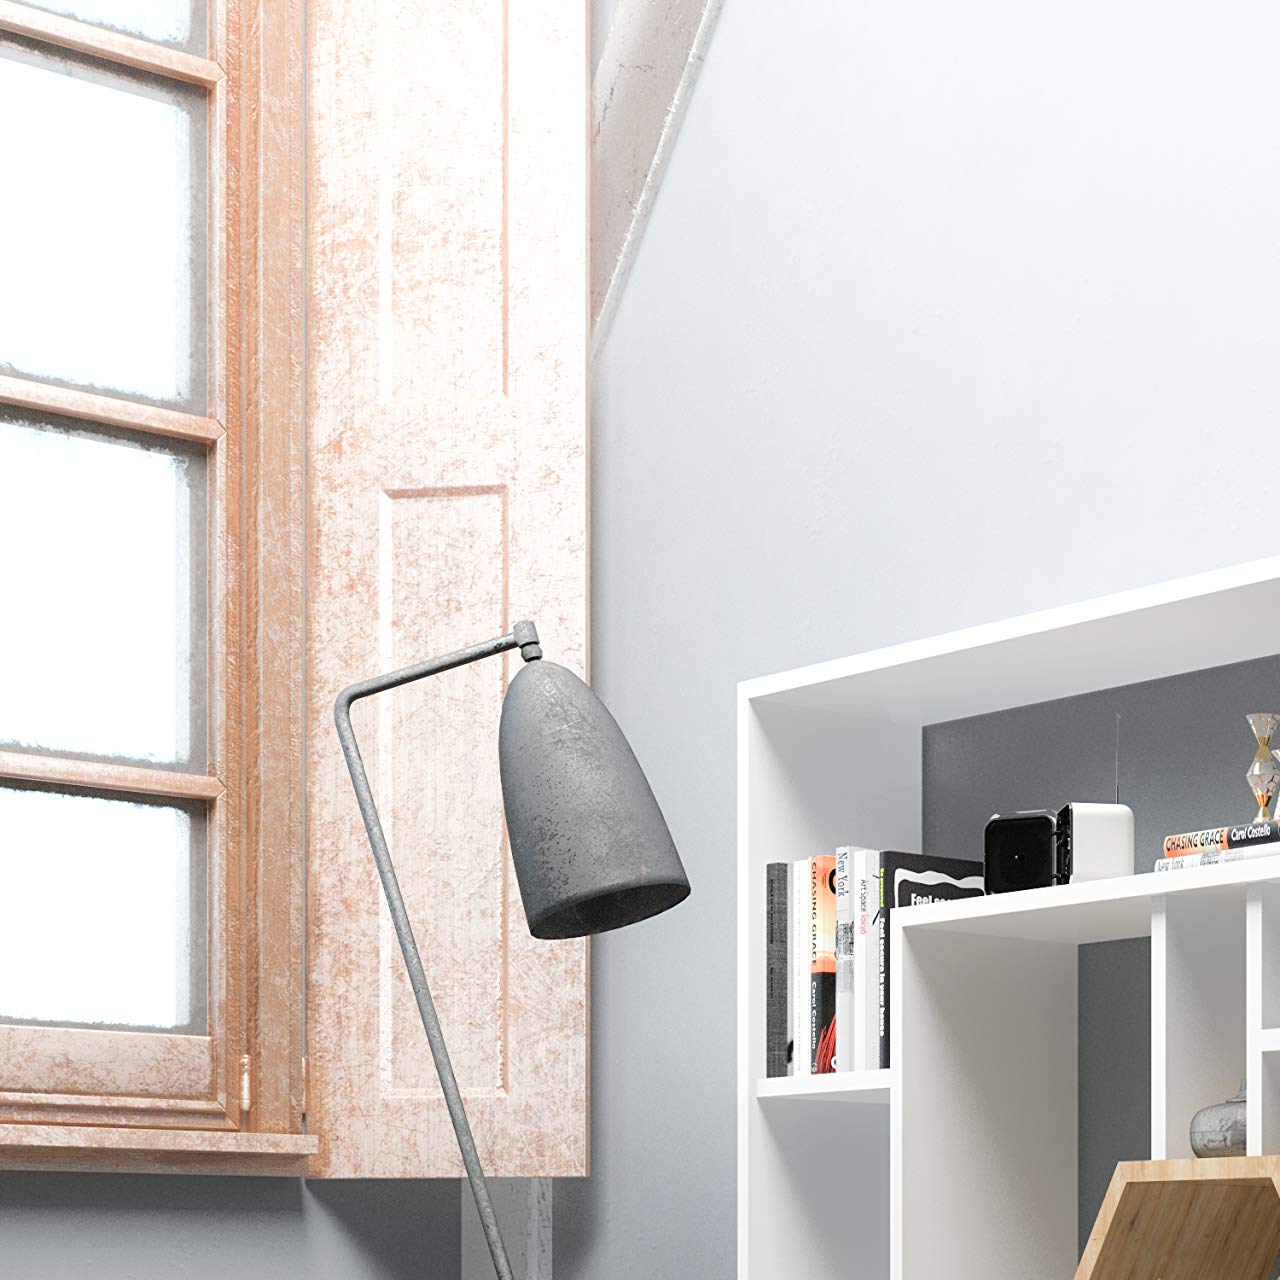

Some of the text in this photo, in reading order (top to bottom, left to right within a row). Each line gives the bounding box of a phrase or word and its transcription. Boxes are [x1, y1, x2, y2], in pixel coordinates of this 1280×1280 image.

[1166, 829, 1224, 852] CHASING GRACE
[1231, 823, 1271, 841] Carol Costello
[837, 852, 849, 897] New York
